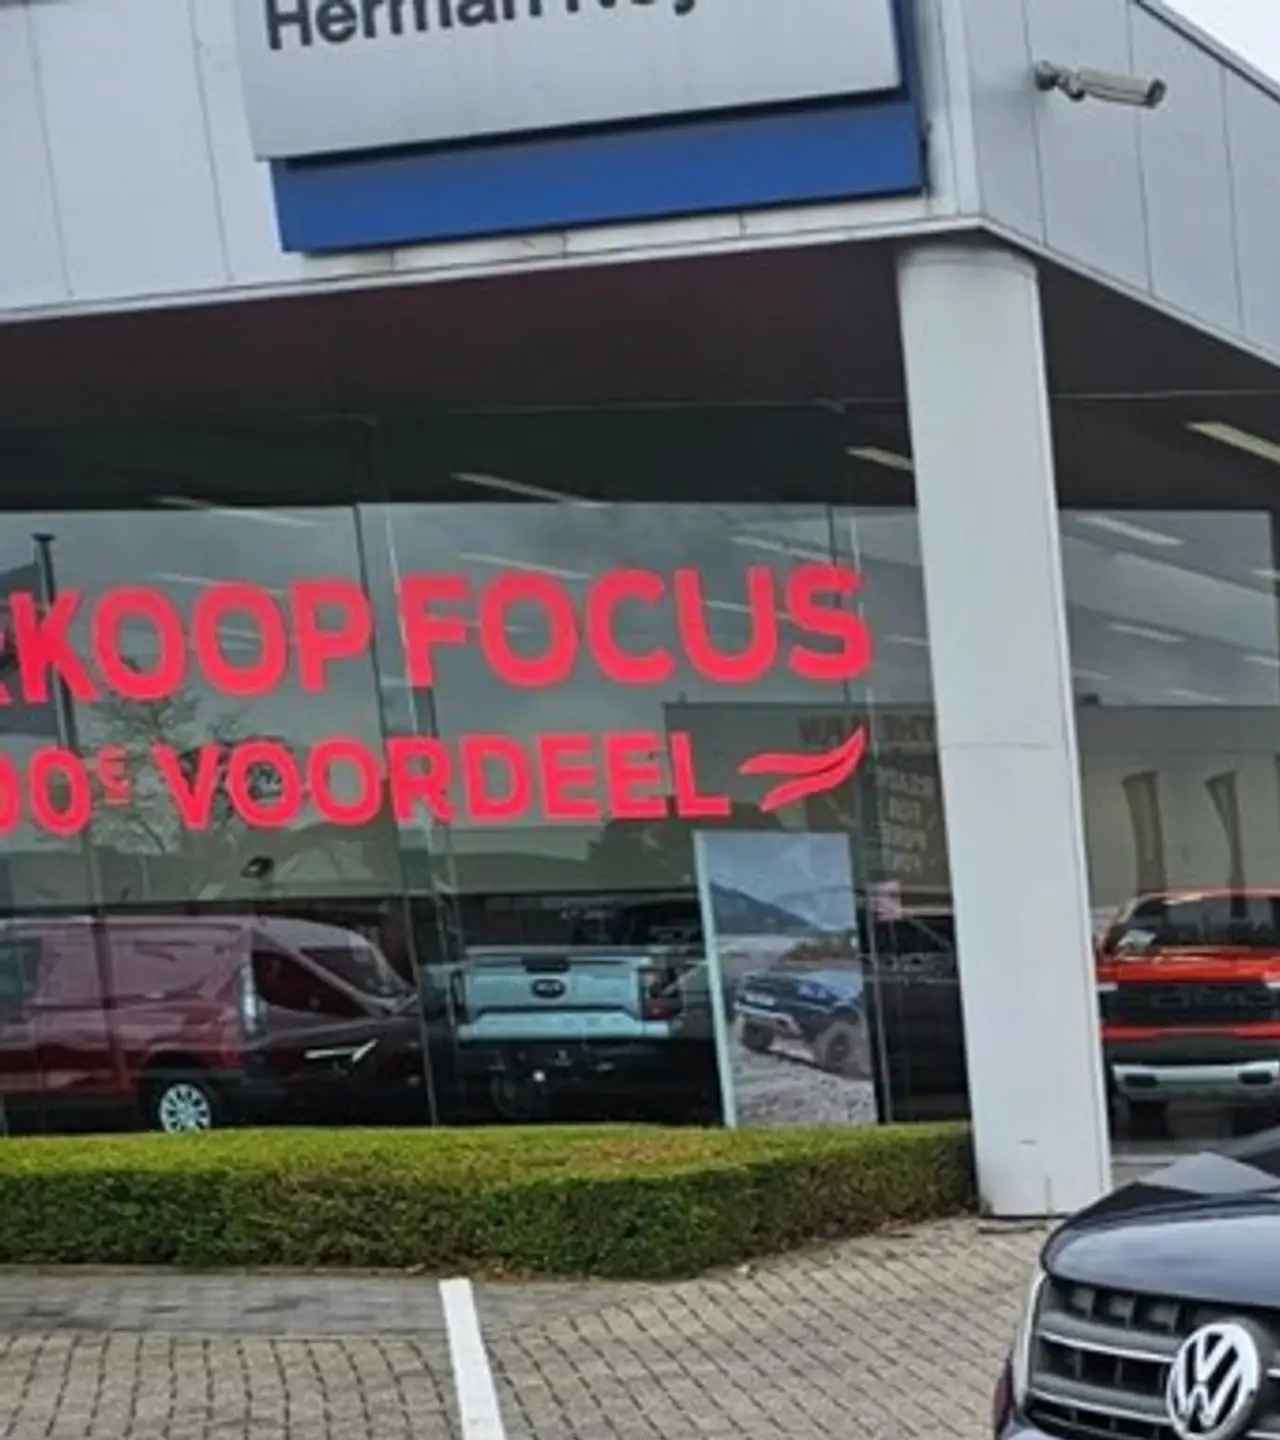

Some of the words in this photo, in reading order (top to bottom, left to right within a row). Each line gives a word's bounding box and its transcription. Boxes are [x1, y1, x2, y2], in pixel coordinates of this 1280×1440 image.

[0, 578, 373, 703] KOOP
[399, 565, 872, 689] FOCUS
[152, 732, 732, 830] VOORDEEL
